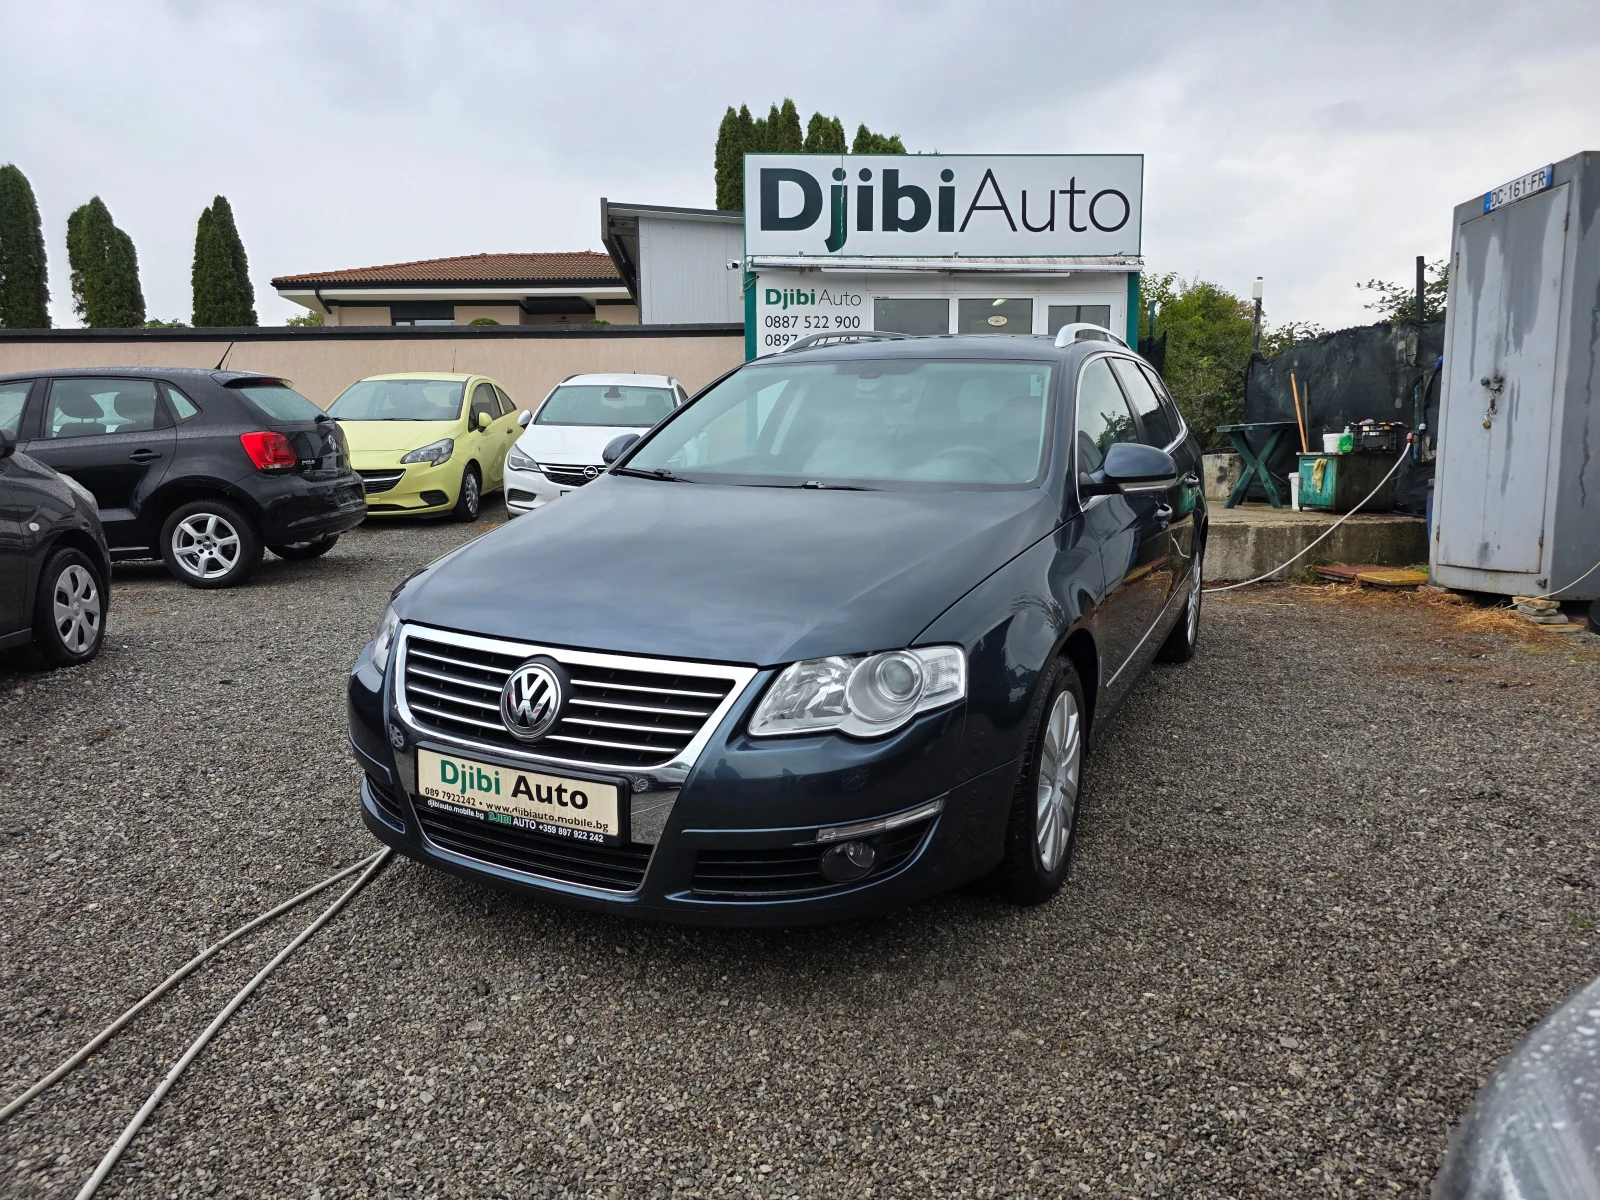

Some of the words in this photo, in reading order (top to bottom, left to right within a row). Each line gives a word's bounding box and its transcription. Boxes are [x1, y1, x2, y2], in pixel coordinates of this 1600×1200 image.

[1491, 170, 1546, 208] DC-161-FR
[765, 315, 799, 329] 0887
[804, 315, 830, 329] 522
[835, 315, 861, 329] 900
[424, 786, 440, 798] 089
[442, 790, 476, 806] 7922242
[440, 759, 501, 796] Djibi
[511, 774, 589, 810] Auto
[427, 798, 485, 820] djibiauto.mobile.bg
[487, 810, 512, 825] DJIBI
[512, 817, 537, 830] AUTO
[538, 823, 557, 834] +359
[558, 827, 572, 837] 897
[573, 829, 588, 840] 922
[589, 832, 604, 843] 242
